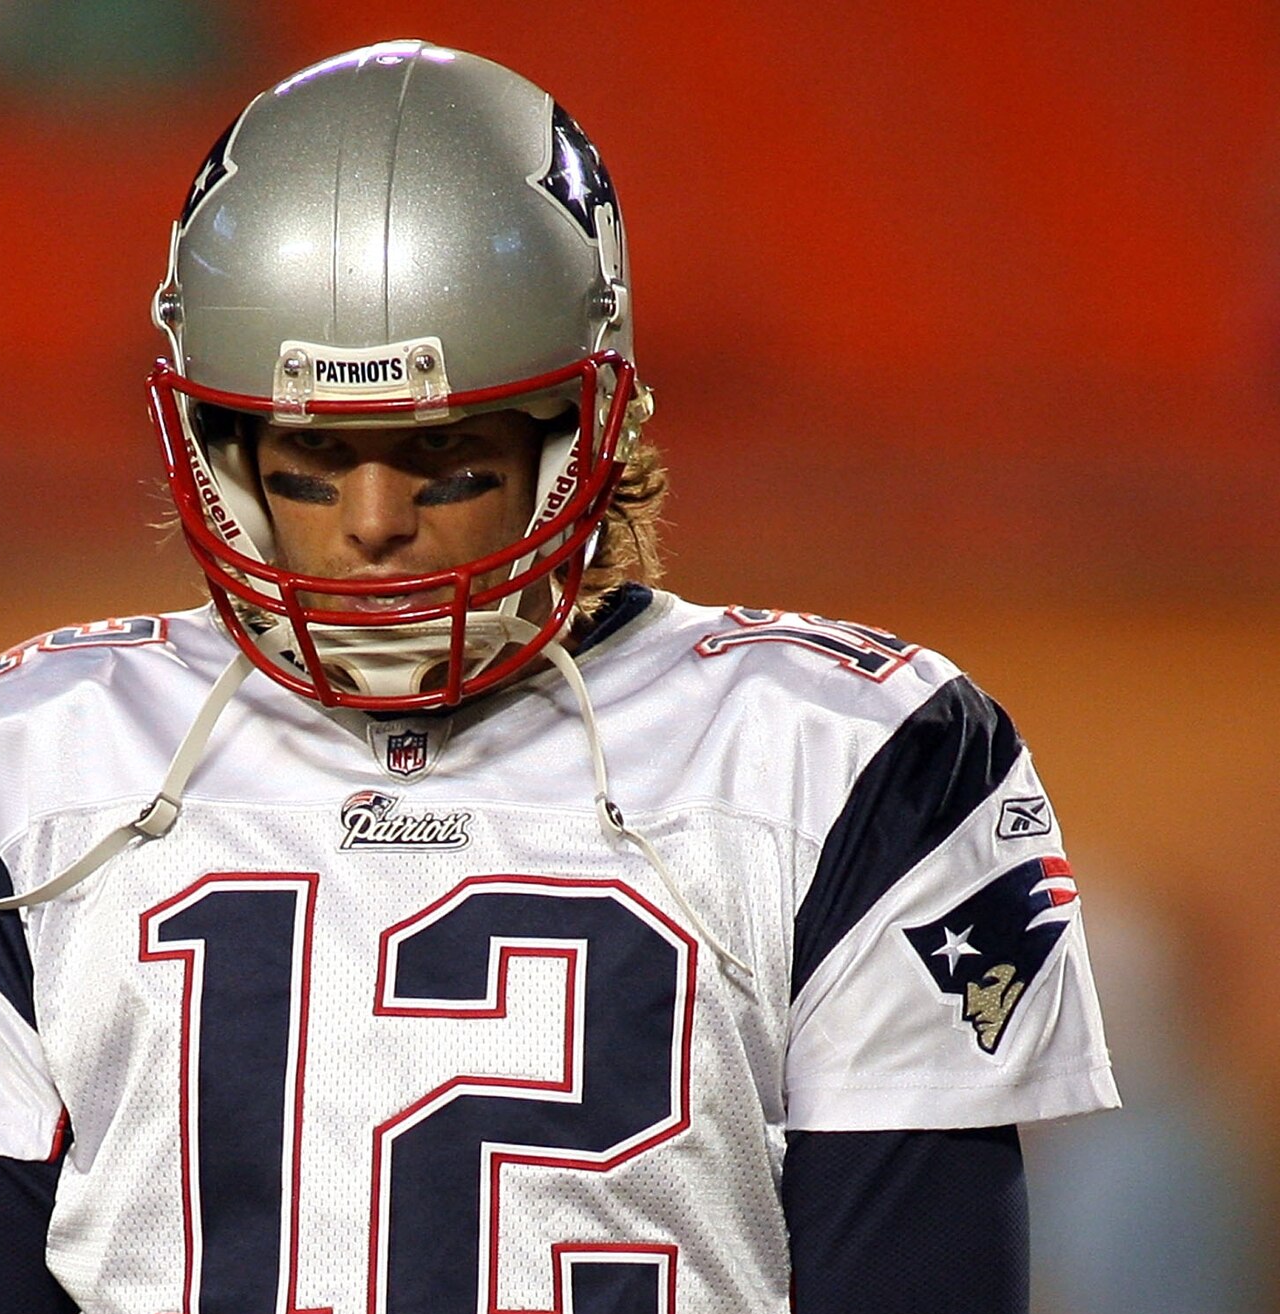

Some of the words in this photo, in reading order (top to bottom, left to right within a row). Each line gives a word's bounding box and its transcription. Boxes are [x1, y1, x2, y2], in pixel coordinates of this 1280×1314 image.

[315, 357, 403, 383] PATRIOTS
[389, 747, 423, 769] NFL
[340, 806, 471, 849] Patriots
